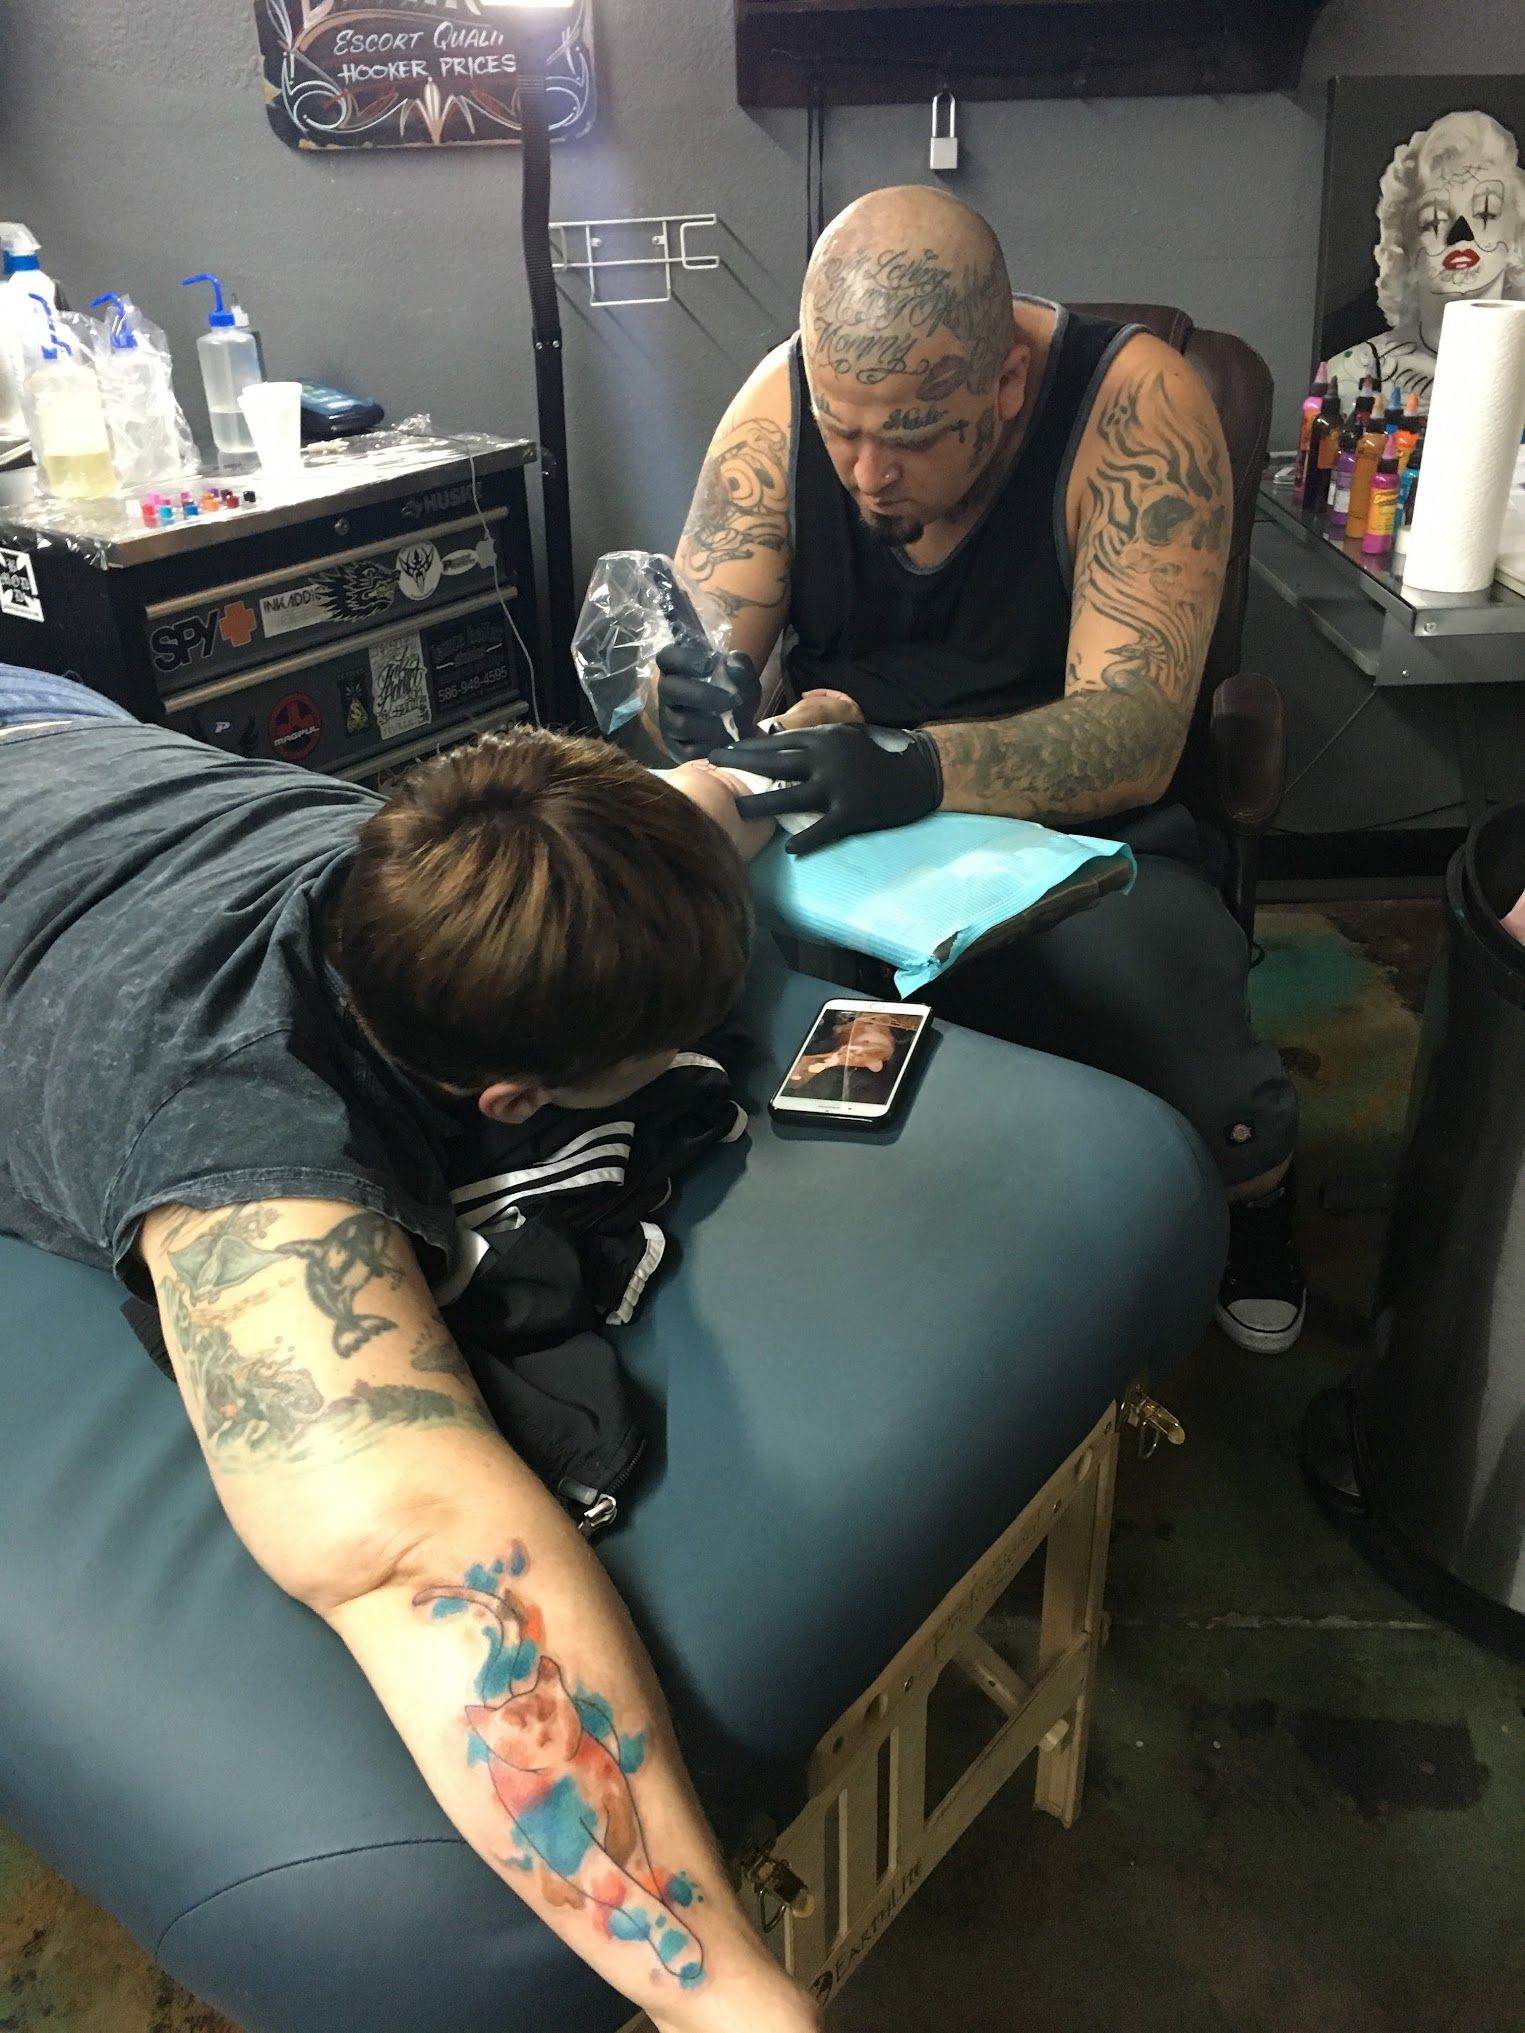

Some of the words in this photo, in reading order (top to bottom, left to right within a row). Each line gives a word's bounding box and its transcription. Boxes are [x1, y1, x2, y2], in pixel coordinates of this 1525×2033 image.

[334, 29, 423, 55] ESCORT
[433, 21, 504, 51] QUALI
[337, 60, 428, 84] HOOKER
[439, 54, 517, 80] PRICES
[150, 608, 219, 672] SPY
[273, 725, 320, 747] MAGPUL
